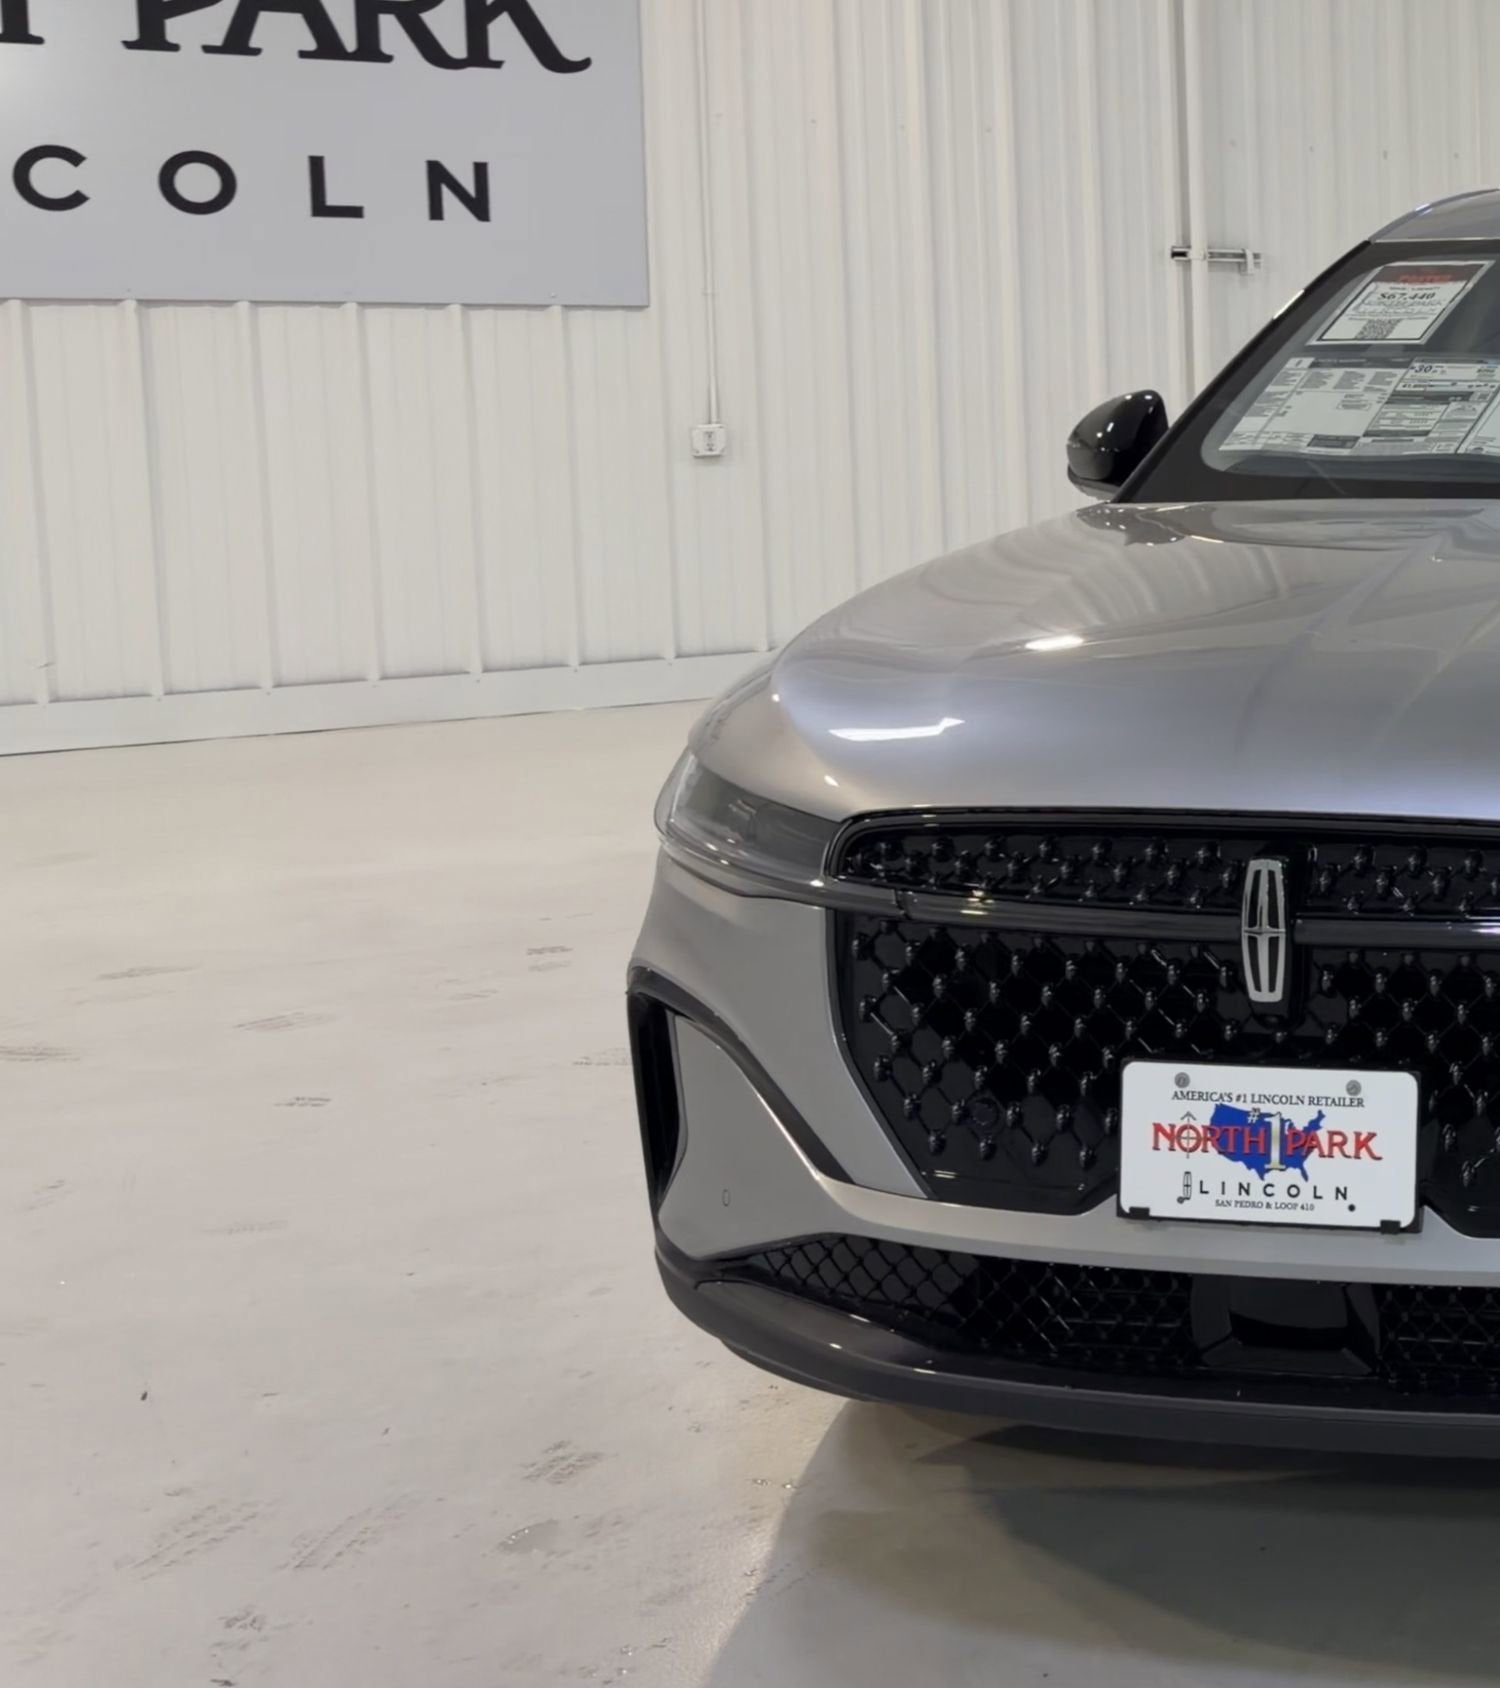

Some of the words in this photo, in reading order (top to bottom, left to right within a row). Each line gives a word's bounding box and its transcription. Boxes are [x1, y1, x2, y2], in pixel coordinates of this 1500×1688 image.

[12, 144, 491, 222] COLN
[1171, 1090, 1233, 1103] AMERICA'S
[1235, 1093, 1248, 1104] #1
[1250, 1093, 1306, 1106] LINCOLN
[1307, 1095, 1365, 1108] RETAILER
[1152, 1122, 1266, 1155] NORTH
[1286, 1128, 1383, 1160] PARK
[1199, 1180, 1348, 1200] LINCOLN
[1215, 1199, 1233, 1208] SAN
[1234, 1200, 1263, 1209] PEDRO
[1275, 1202, 1298, 1210] LOOP
[1300, 1203, 1315, 1211] 410
